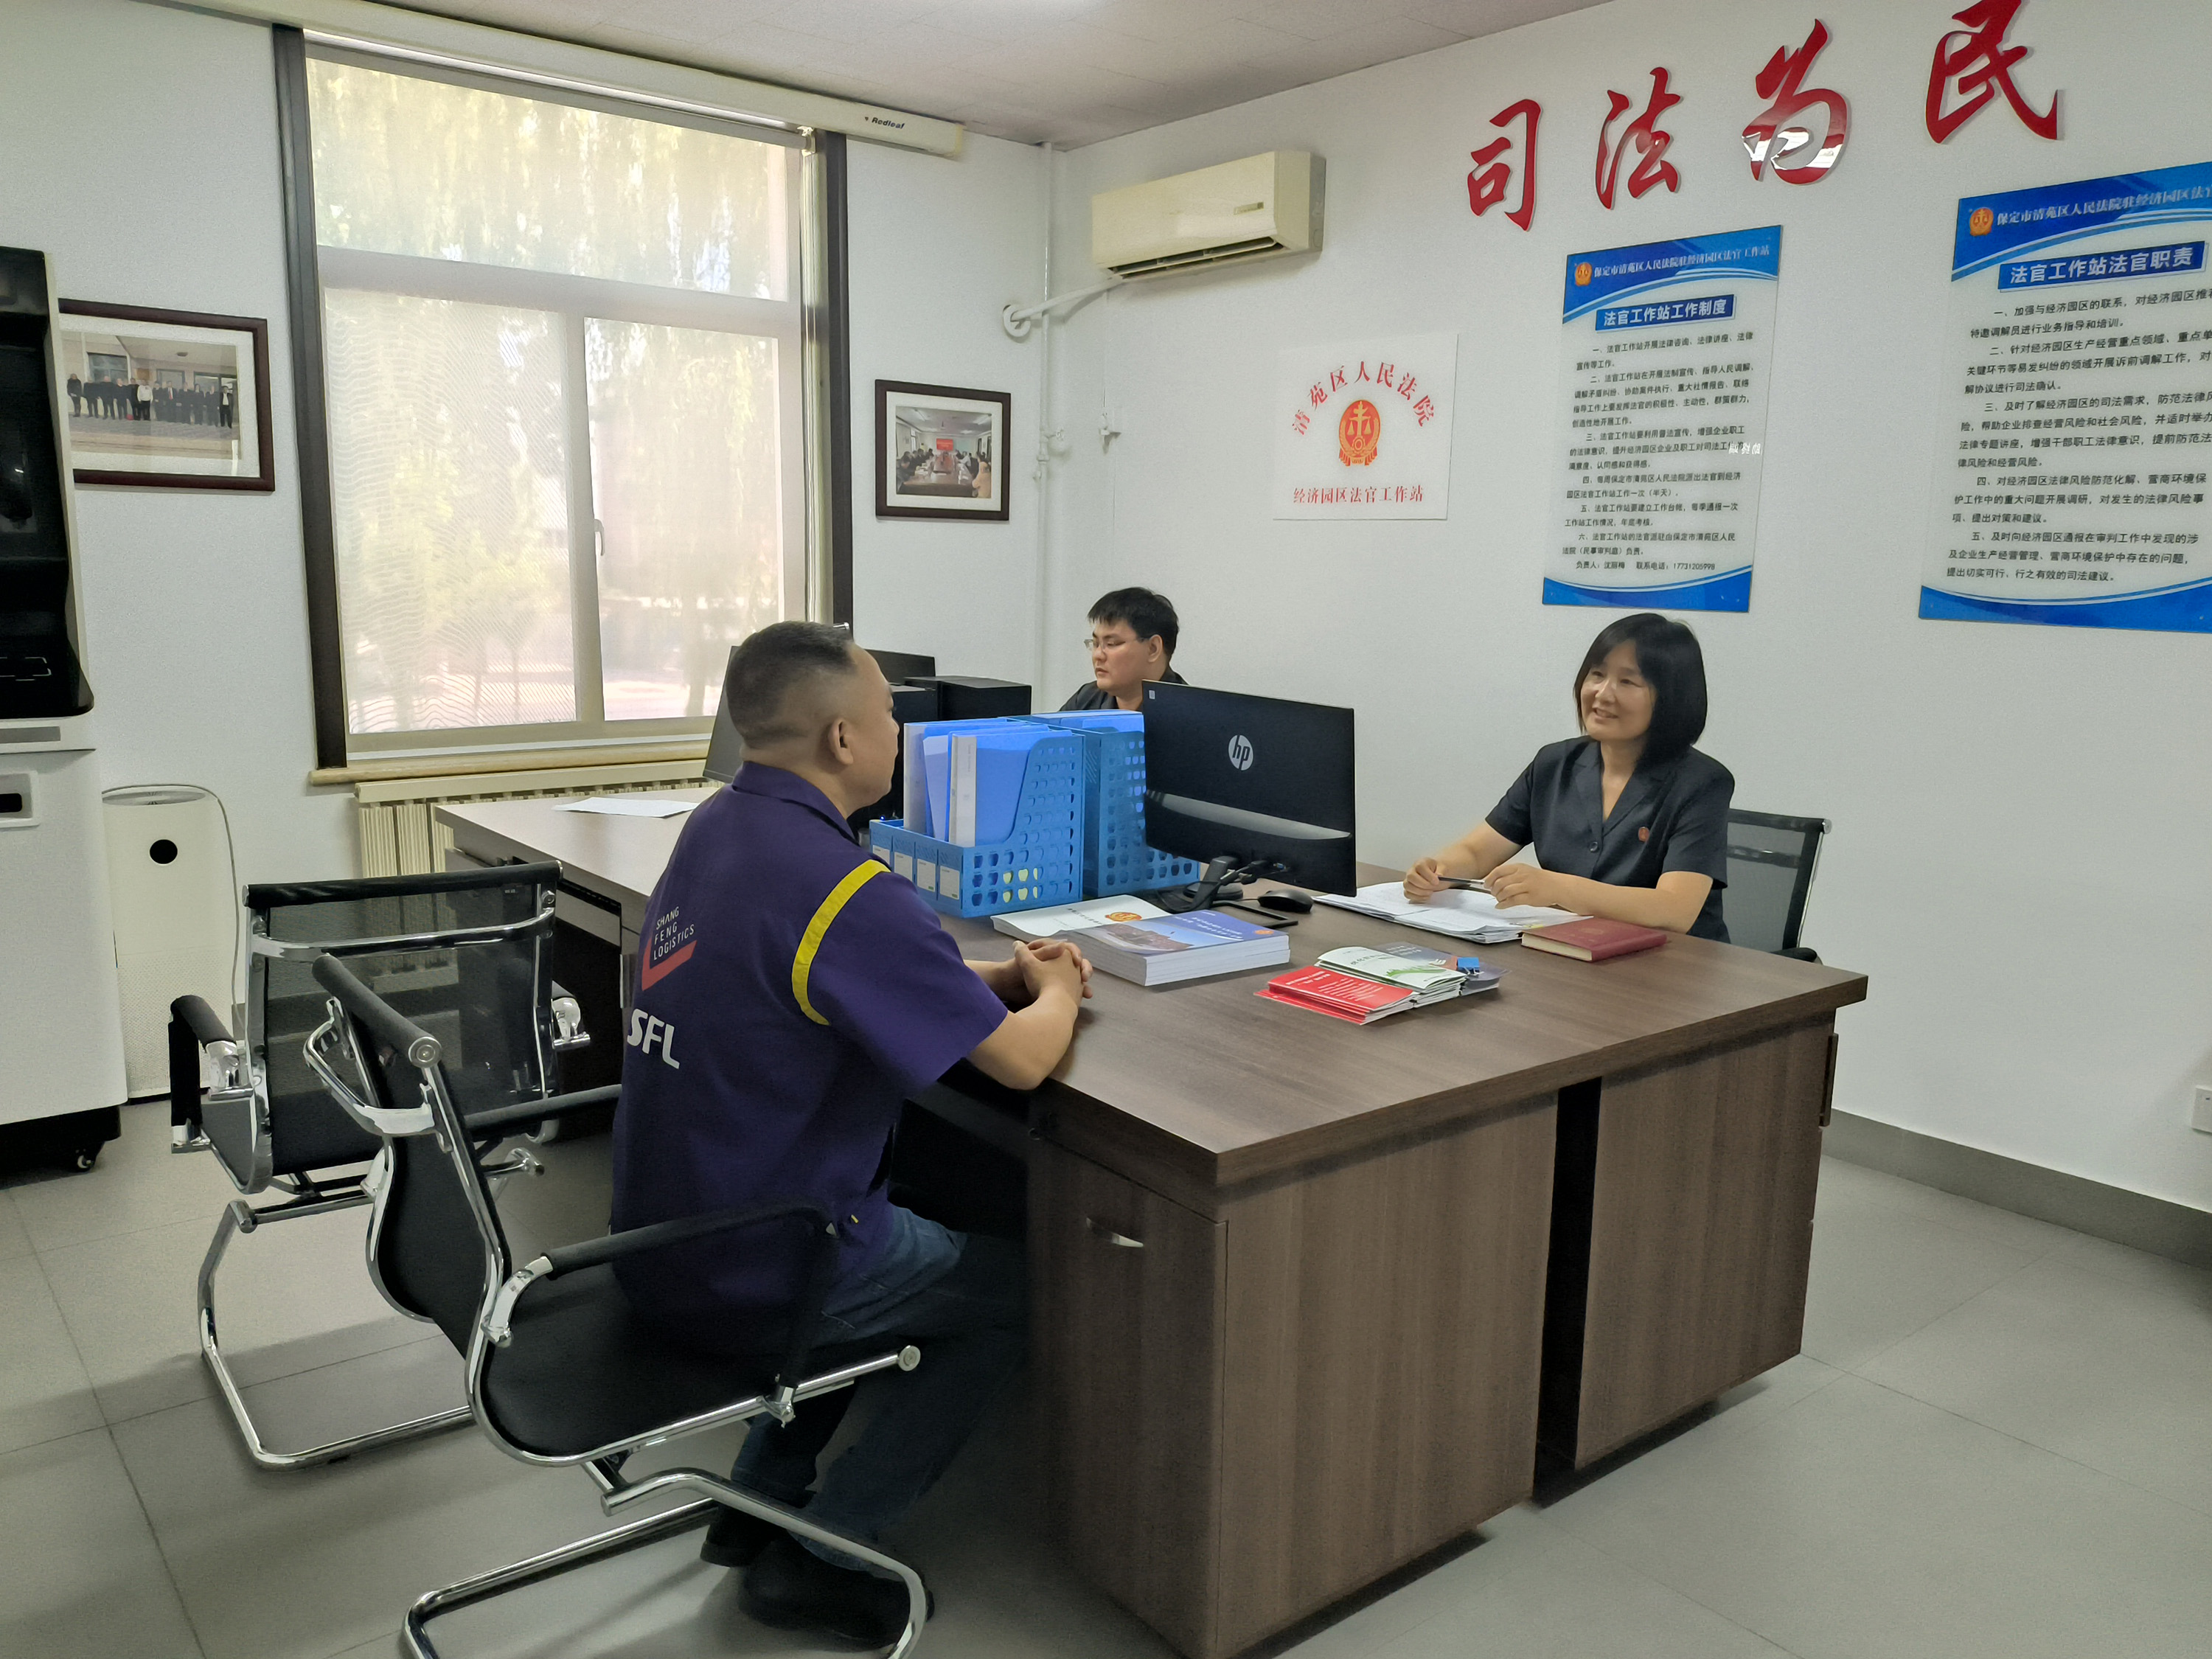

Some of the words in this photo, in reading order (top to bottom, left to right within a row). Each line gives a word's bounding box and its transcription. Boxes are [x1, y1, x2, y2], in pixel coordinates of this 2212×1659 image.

[872, 117, 905, 129] Redleaf
[1467, 0, 2059, 232] 司法为民
[2010, 246, 2194, 284] 法官工作站法官职责
[1603, 299, 1728, 327] 法官工作站工作制度
[1970, 318, 2124, 339] 特邀调解员进行业务指导和培训。
[1292, 361, 1435, 435] 清苑区人民法院
[1964, 380, 2062, 394] 解协议进行司法确认。
[1958, 457, 2042, 468] 律风险和经营风险。
[1293, 484, 1424, 504] 经济园区法官工作站
[1952, 512, 2048, 524] 项、提出对策和建议。
[1229, 734, 1253, 771] hp
[655, 905, 680, 931] SHANG
[653, 923, 695, 961] LOGISTICS
[654, 922, 678, 945] FENG
[627, 1008, 681, 1070] SFL
